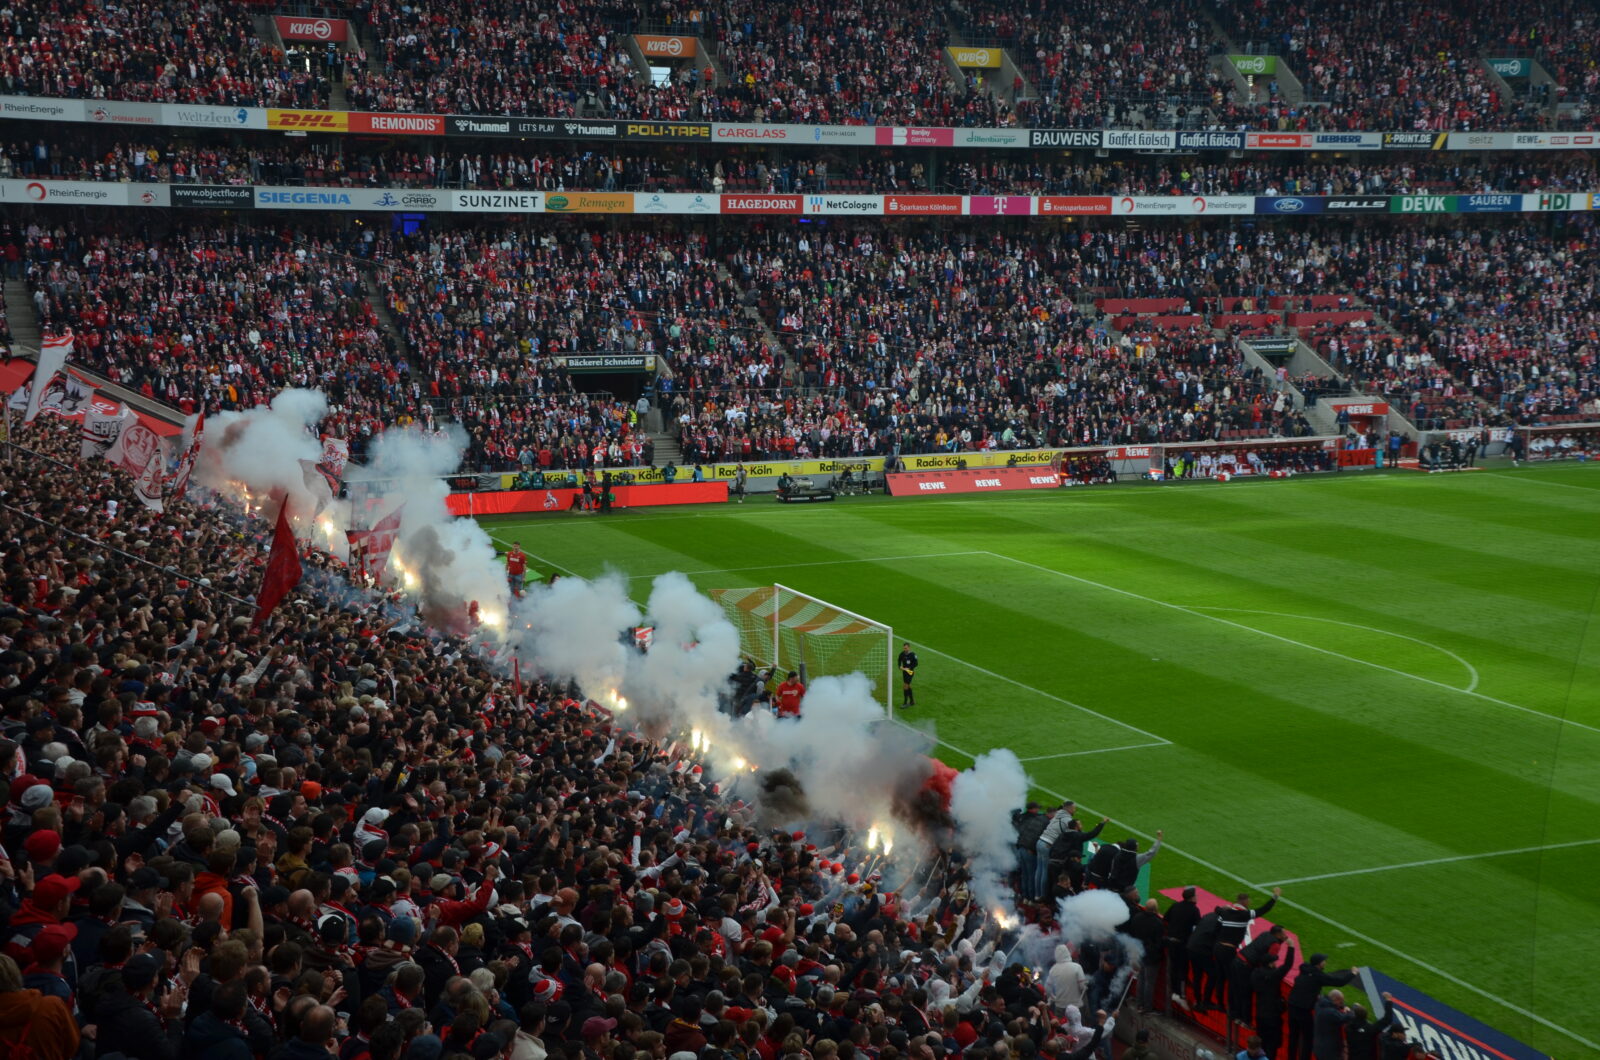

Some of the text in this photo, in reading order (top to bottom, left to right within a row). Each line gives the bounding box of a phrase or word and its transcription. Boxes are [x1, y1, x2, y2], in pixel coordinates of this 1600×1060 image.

[290, 22, 314, 35] KVB
[647, 41, 668, 51] KVB
[957, 52, 977, 62] KVB
[4, 103, 64, 115] RheinEnergie
[177, 111, 232, 124] Weltzien
[279, 114, 337, 128] DHL
[469, 120, 510, 133] hummel
[518, 123, 555, 133] LET'S PLAY
[577, 124, 617, 136] hummel
[627, 124, 710, 138] POLI-TAPE
[717, 128, 786, 138] CARGLASS
[1384, 133, 1432, 144] X-PRINT.DE
[1032, 132, 1100, 146] BAUWENS
[1108, 132, 1170, 148] Gaffel Kölsch
[1180, 133, 1208, 147] Gaffel
[1209, 133, 1241, 148] Kölsch
[1316, 135, 1362, 144] LIEBHERR
[1468, 135, 1494, 145] seitz
[1516, 135, 1538, 144] REWE
[49, 188, 108, 200] RheinEnergie
[175, 188, 250, 199] www.objectflor.de
[259, 192, 352, 205] SIEGENIA
[401, 196, 437, 206] CARBO
[459, 195, 539, 208] SUNZINET
[579, 197, 625, 211] Remagen
[727, 199, 797, 210] HAGEDORN
[826, 200, 878, 212] NetCologne
[1328, 201, 1387, 209] BULLS
[1401, 197, 1446, 212] DEVK
[1469, 195, 1512, 206] SAUREN
[1539, 194, 1572, 210] HDI
[900, 203, 957, 212] Sparkasse KölnBonn
[1053, 204, 1094, 212] Kreissparkasse
[1136, 202, 1177, 211] RheinEnergie
[1207, 202, 1247, 211] RheinEnergie
[568, 356, 644, 367] Bäckerei Schneider
[1346, 404, 1374, 414] REWE
[1125, 447, 1149, 457] REWE
[916, 458, 943, 468] Radio
[638, 470, 662, 480] Köln
[750, 465, 772, 475] Köln
[918, 481, 946, 490] REWE
[975, 479, 1002, 488] REWE
[1029, 475, 1056, 485] REWE
